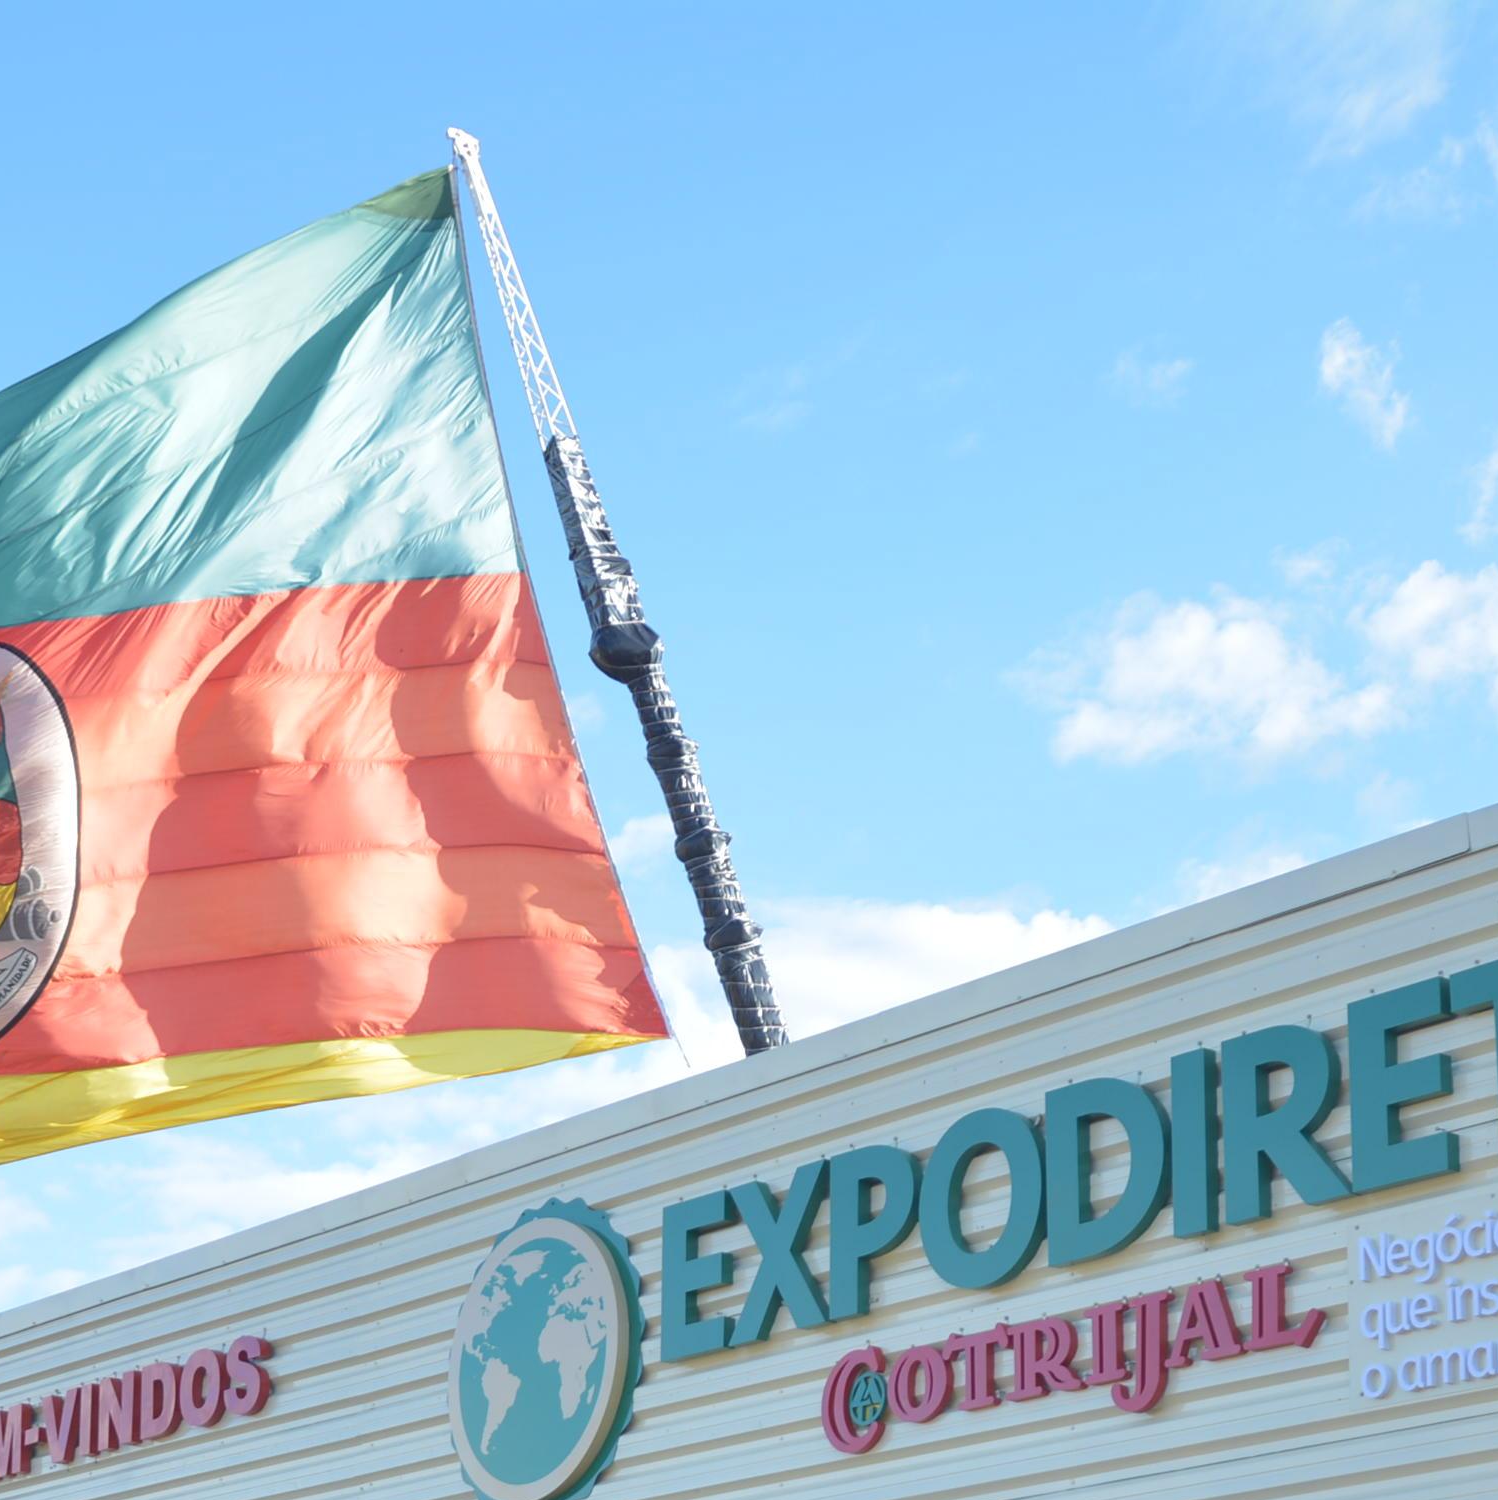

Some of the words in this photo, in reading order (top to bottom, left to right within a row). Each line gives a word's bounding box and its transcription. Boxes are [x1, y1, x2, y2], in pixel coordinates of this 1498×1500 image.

[1359, 1294, 1439, 1350] que
[821, 1262, 1326, 1454] COTRIJAL
[1360, 1362, 1393, 1399] o
